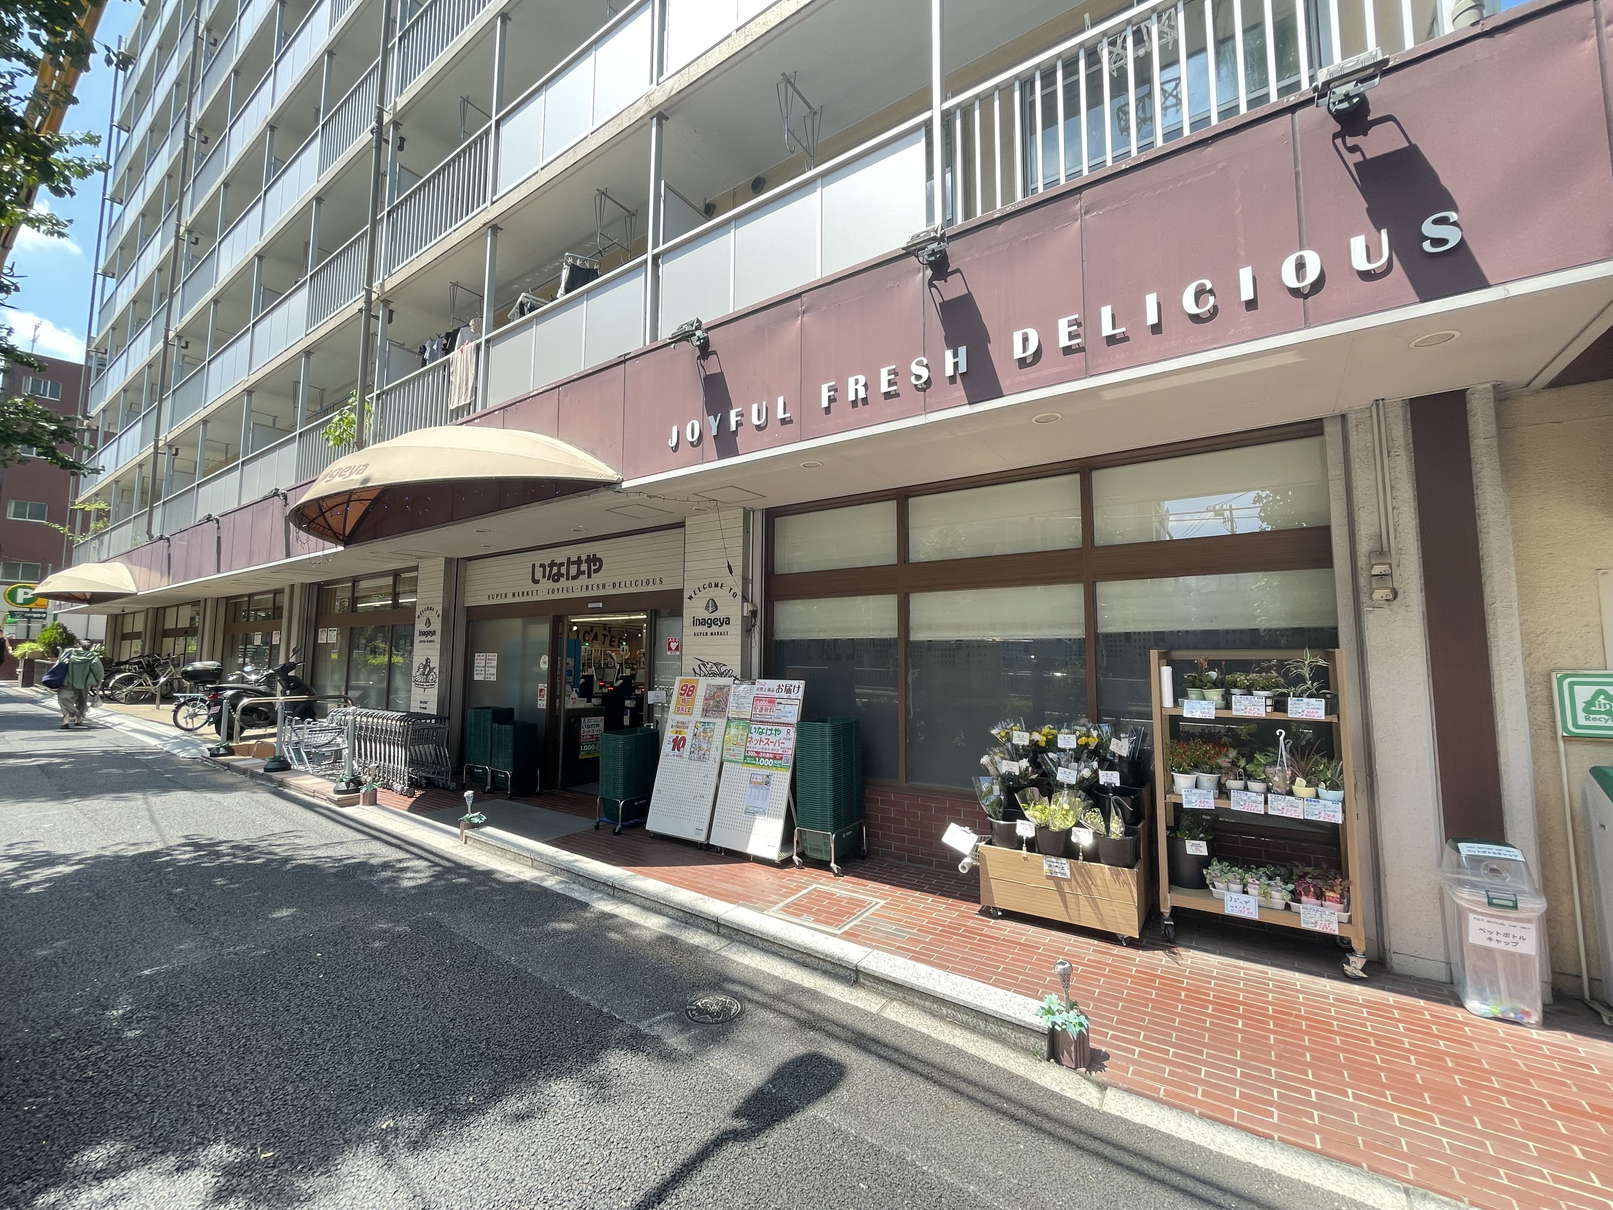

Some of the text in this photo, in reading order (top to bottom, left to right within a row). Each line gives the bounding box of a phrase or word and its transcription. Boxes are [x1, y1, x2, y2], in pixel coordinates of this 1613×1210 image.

[668, 211, 1462, 448] JOYFUL FRESH DELICIOUS
[17, 588, 35, 603] P
[487, 577, 664, 601] SUPER MARKET JOYFUL FRESH DELICIOUS
[687, 582, 738, 601] WELCOME TO
[692, 616, 731, 628] inageya
[679, 684, 696, 697] 98
[775, 683, 801, 694] お届け
